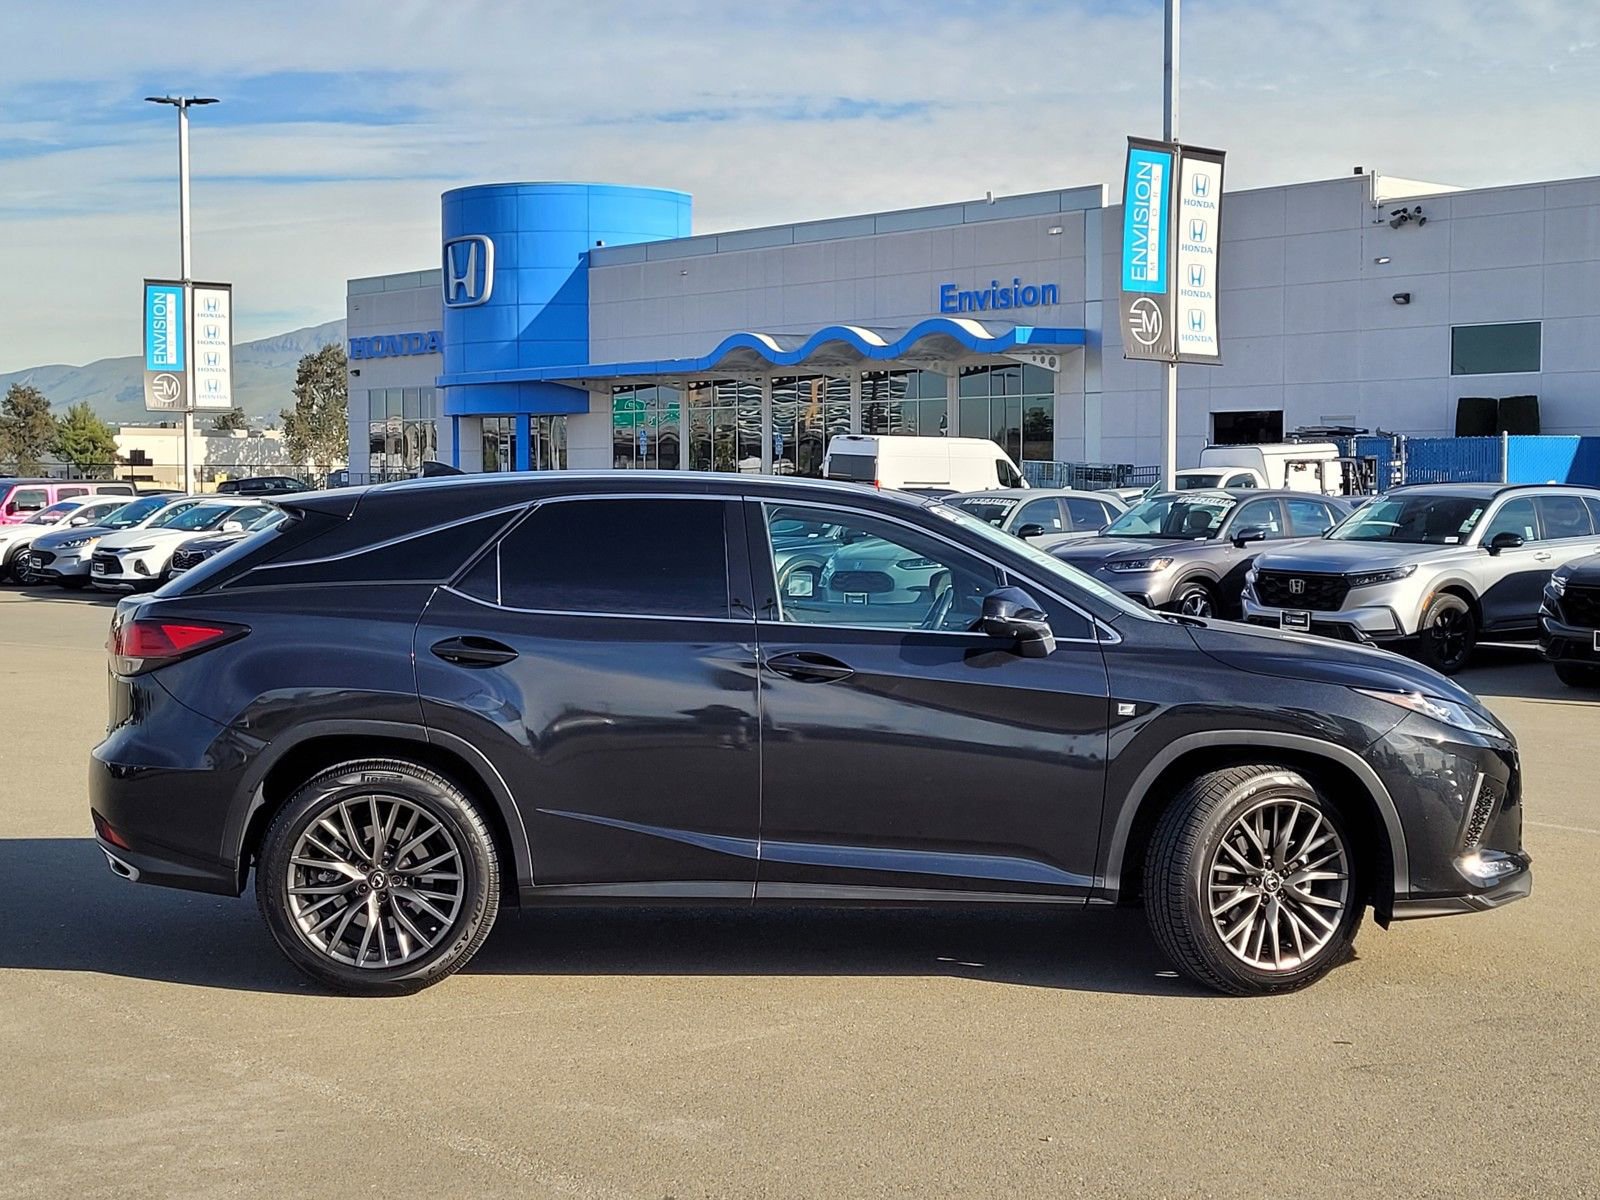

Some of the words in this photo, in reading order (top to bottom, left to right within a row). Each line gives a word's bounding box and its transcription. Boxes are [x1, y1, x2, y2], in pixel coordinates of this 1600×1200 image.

[1183, 198, 1215, 209] HONDA
[1131, 161, 1152, 281] ENVISION
[1181, 243, 1213, 254] HONDA
[940, 276, 1059, 313] Envision
[1180, 288, 1212, 299] HONDA
[153, 292, 167, 364] ENVISION
[1182, 333, 1214, 343] HONDA
[349, 331, 443, 360] HONDA
